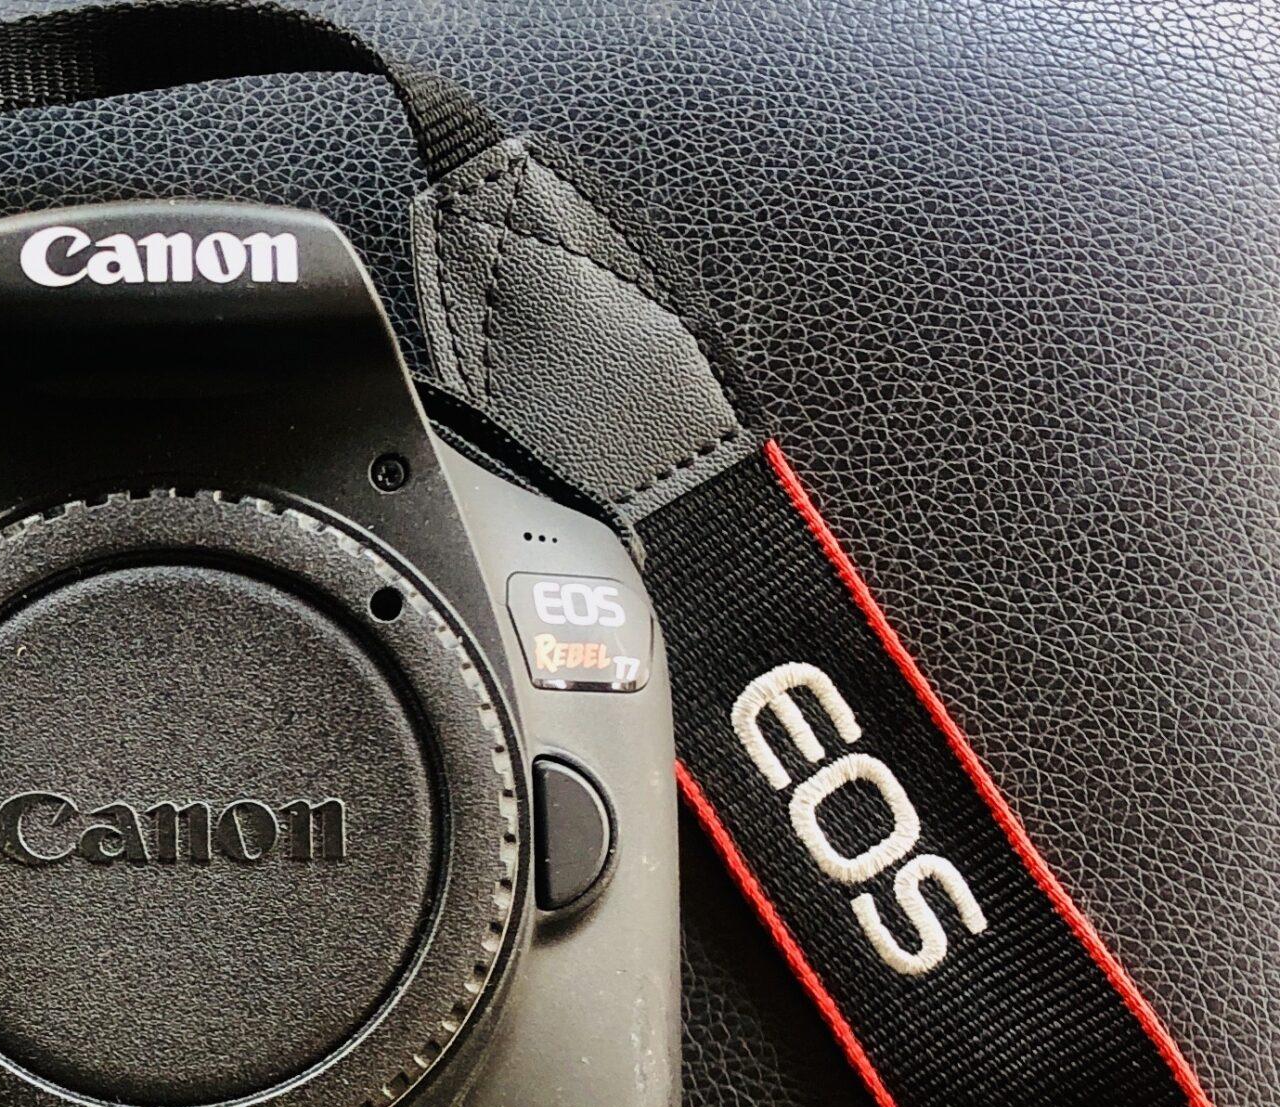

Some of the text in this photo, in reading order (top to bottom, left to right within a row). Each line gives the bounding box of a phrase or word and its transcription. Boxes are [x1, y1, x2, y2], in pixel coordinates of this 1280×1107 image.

[20, 226, 300, 288] Canon
[532, 581, 626, 628] EOS
[533, 633, 641, 681] REBEL T7
[730, 660, 989, 976] EOS
